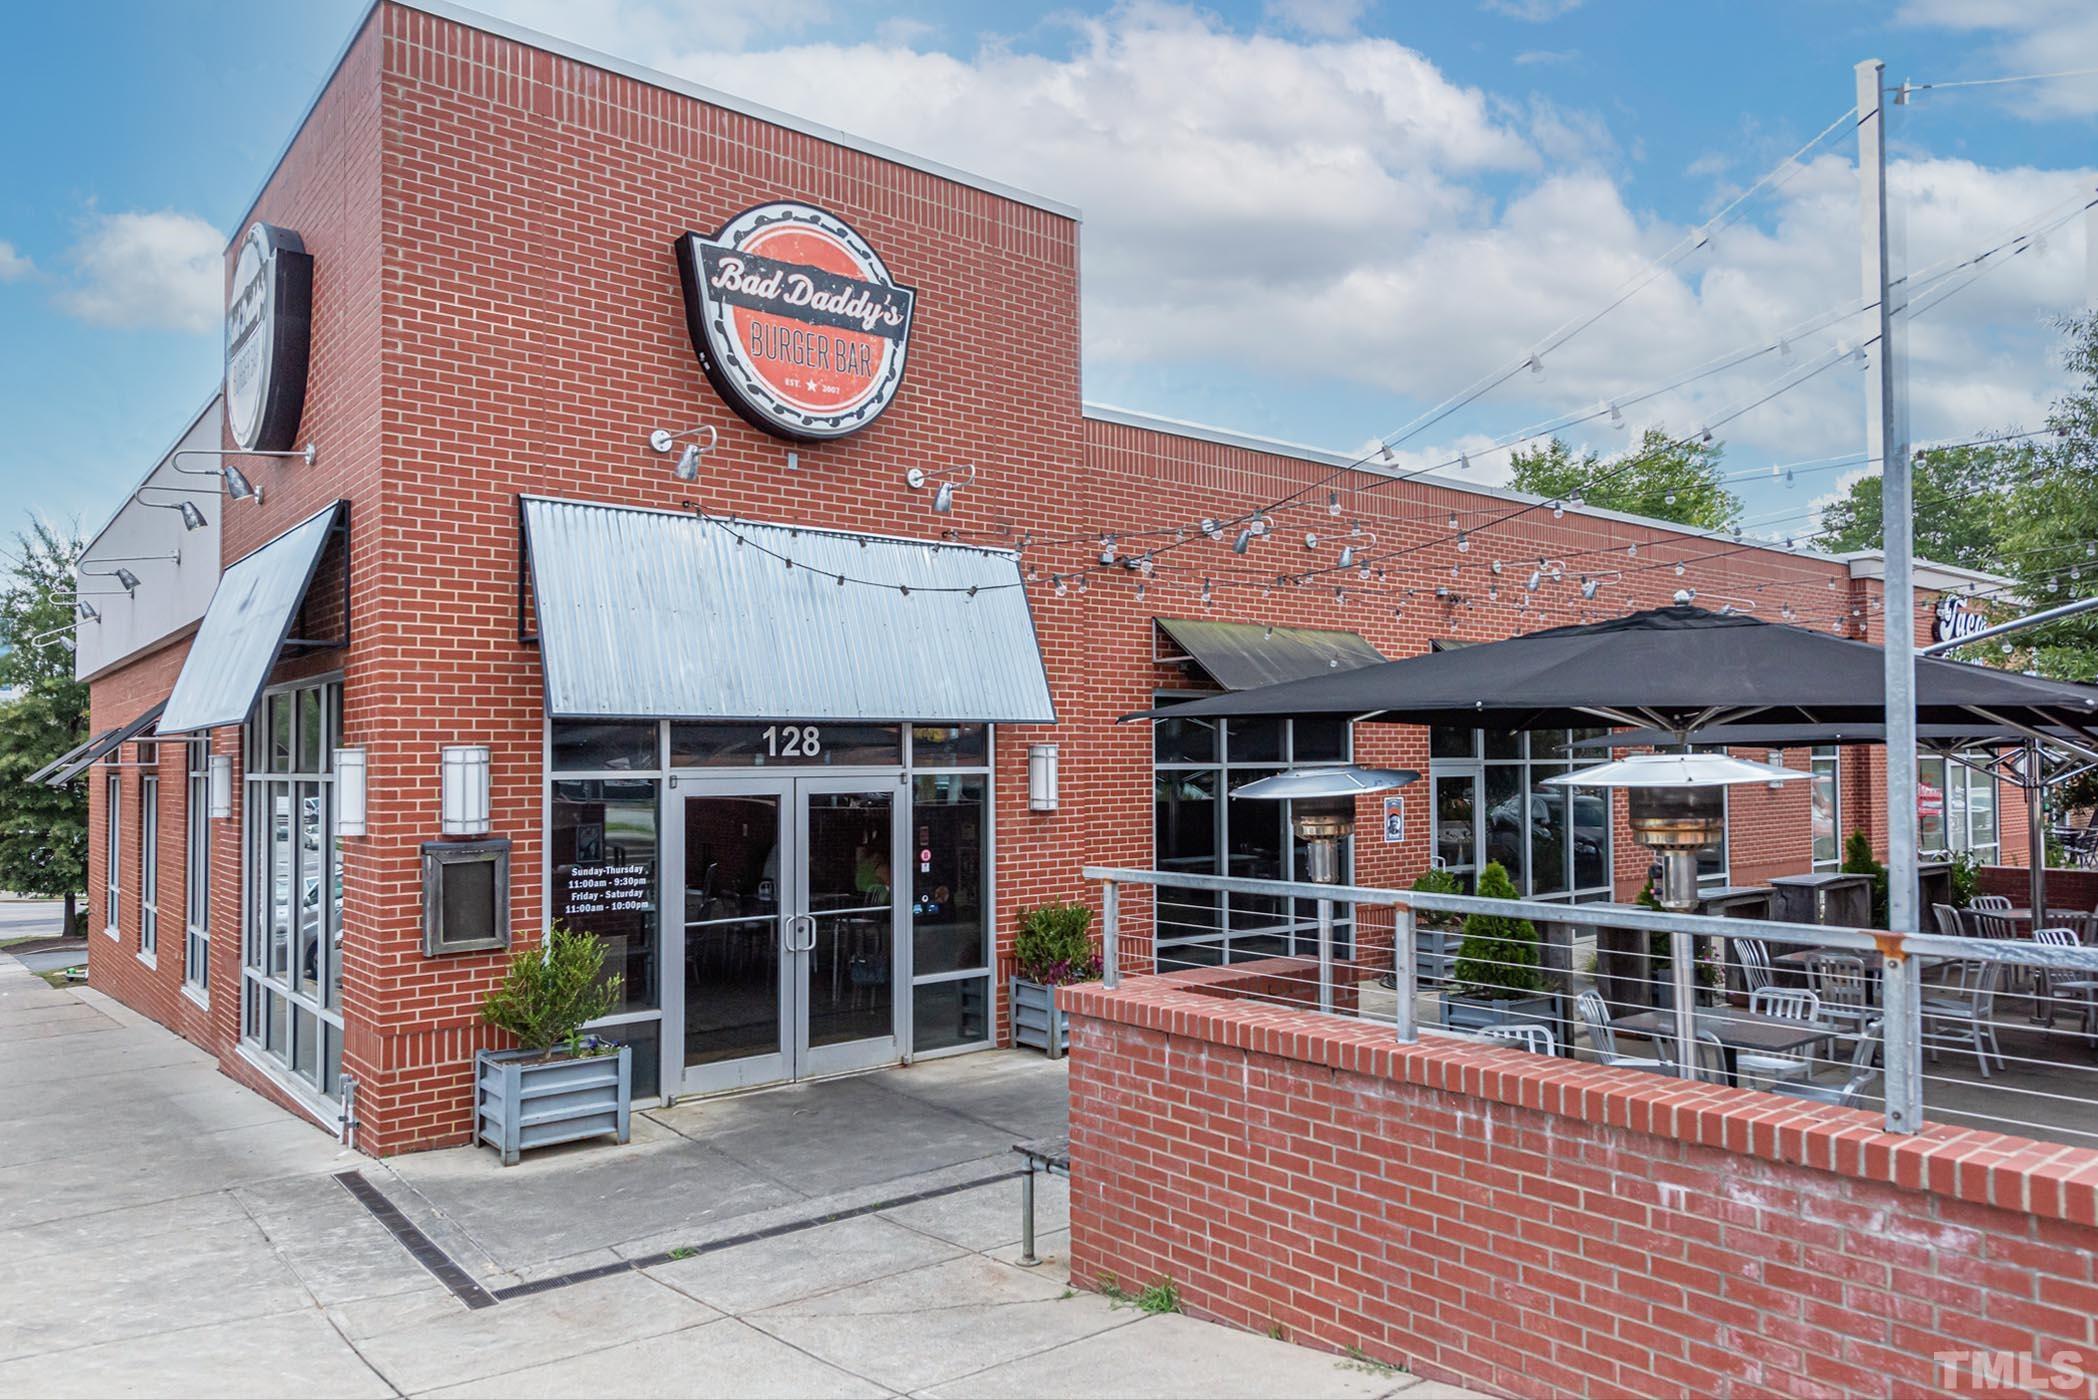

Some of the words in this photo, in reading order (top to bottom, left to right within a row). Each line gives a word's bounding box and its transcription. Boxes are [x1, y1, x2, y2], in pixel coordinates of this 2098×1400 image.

[711, 257, 784, 300] Bad
[783, 274, 904, 330] Daddy's
[751, 321, 829, 369] BURGER
[835, 338, 872, 378] BAR
[762, 726, 820, 757] 128
[571, 865, 644, 876] Sunday-Thursday
[568, 879, 607, 889] 11:00am
[614, 877, 647, 887] 9:30pm
[571, 891, 598, 901] Friday
[605, 889, 644, 899] Saturday
[565, 904, 604, 914] 11:00am
[611, 901, 649, 911] 10:00pm
